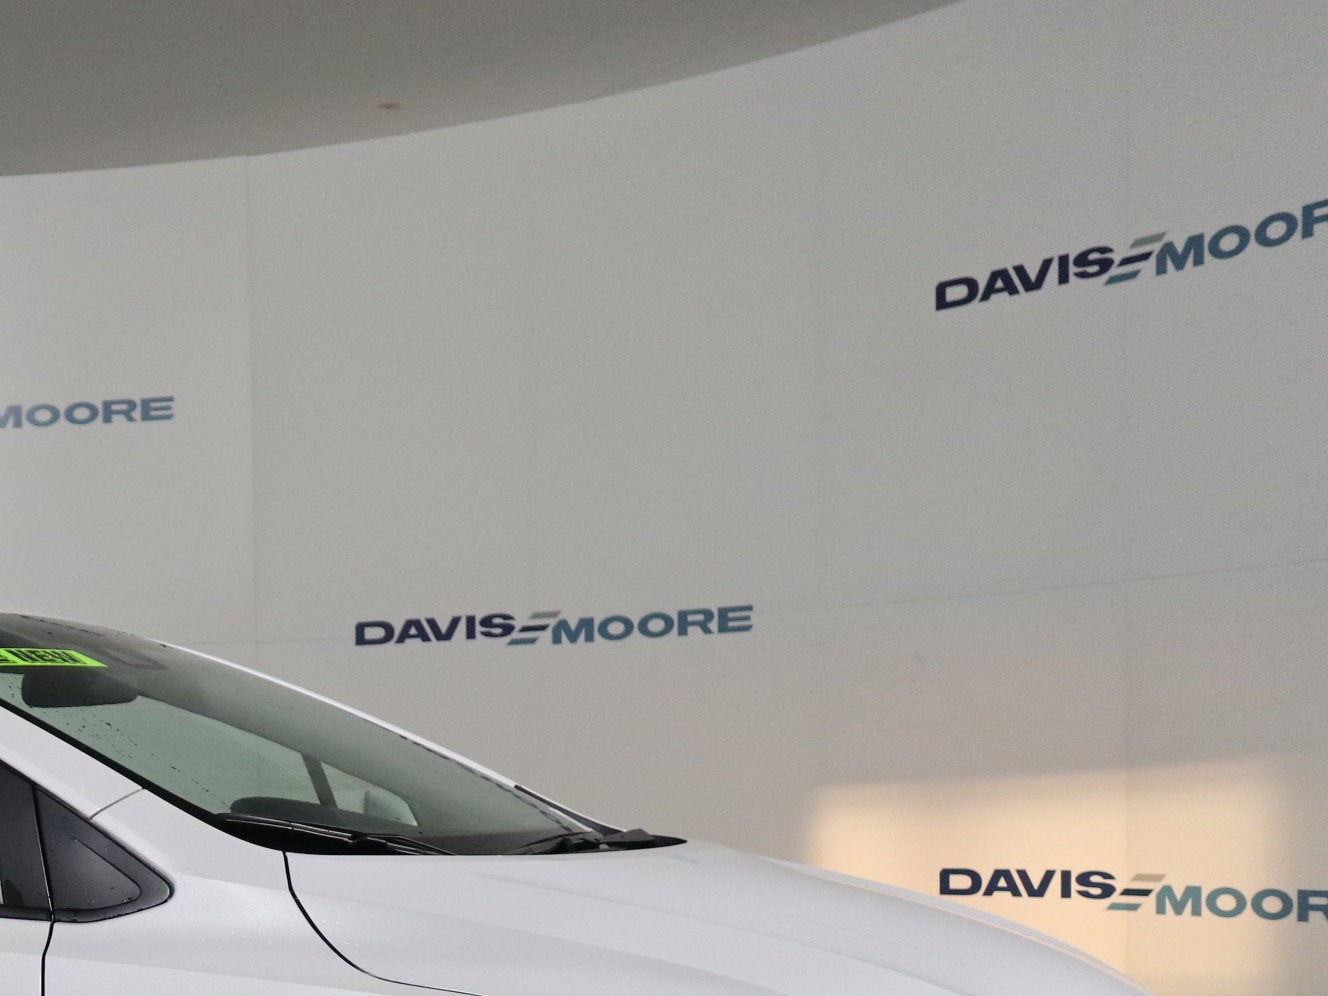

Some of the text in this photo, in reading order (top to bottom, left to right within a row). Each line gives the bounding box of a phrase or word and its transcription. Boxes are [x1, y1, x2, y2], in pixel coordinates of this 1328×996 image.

[935, 245, 1115, 312] DAVIS
[355, 604, 754, 646] DAVIS MOORE
[6, 649, 87, 665] NEW
[939, 867, 1328, 922] DAVIS MOOR
